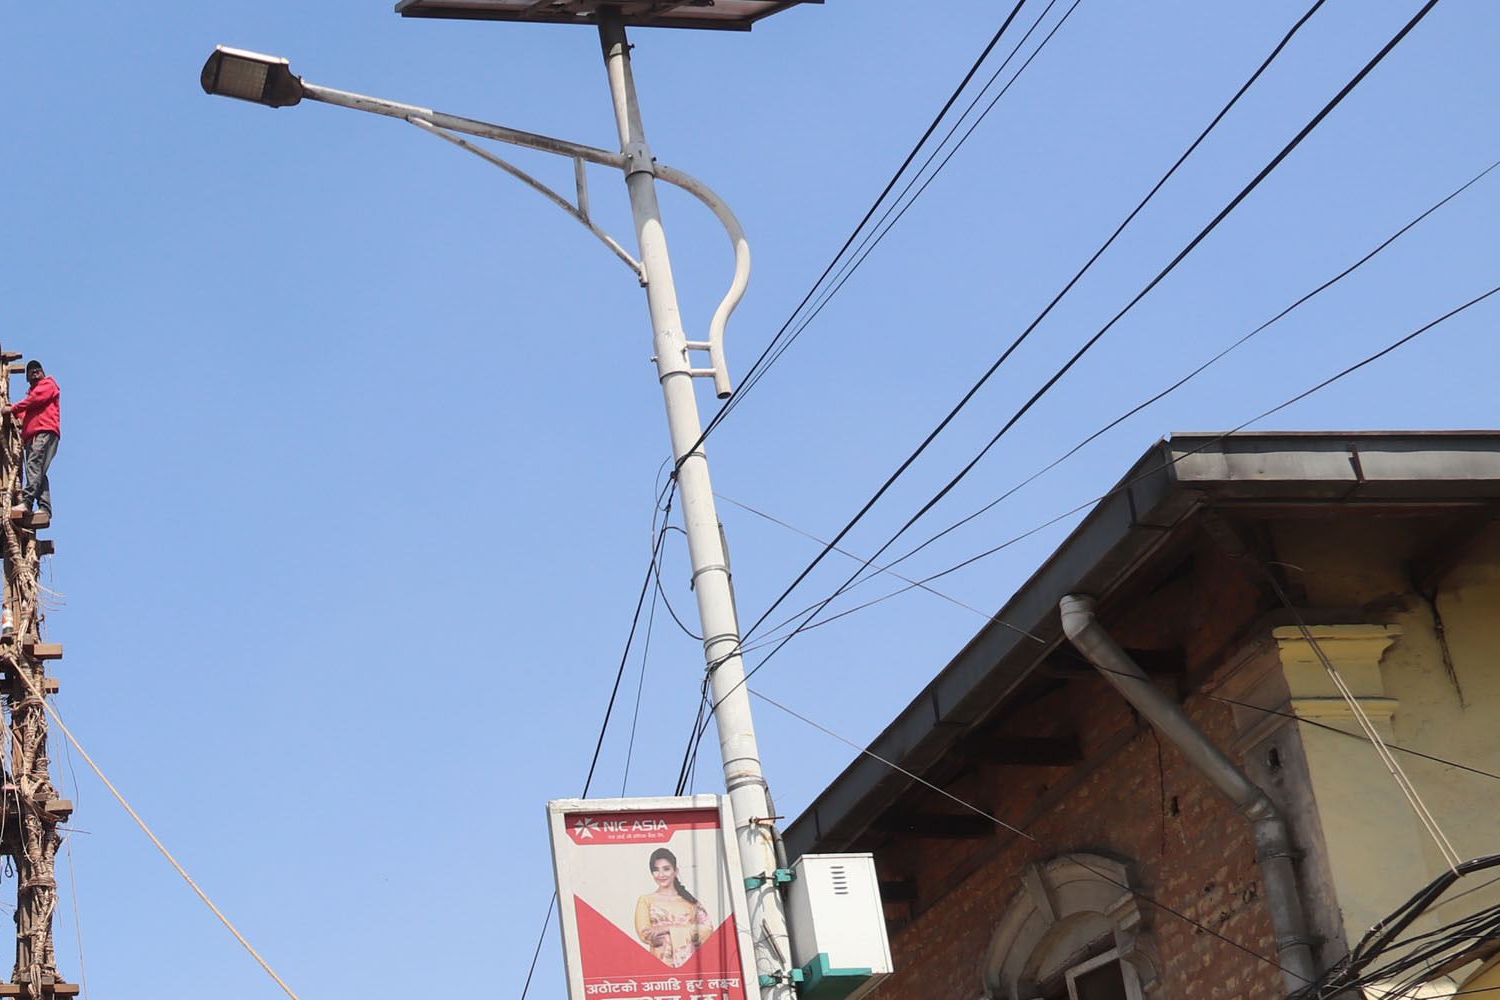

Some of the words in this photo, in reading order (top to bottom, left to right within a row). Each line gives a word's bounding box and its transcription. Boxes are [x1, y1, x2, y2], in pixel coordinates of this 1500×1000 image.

[603, 821, 629, 832] NIC
[632, 819, 669, 831] ASIA
[642, 977, 681, 992] अगाडि
[686, 979, 703, 993] हर
